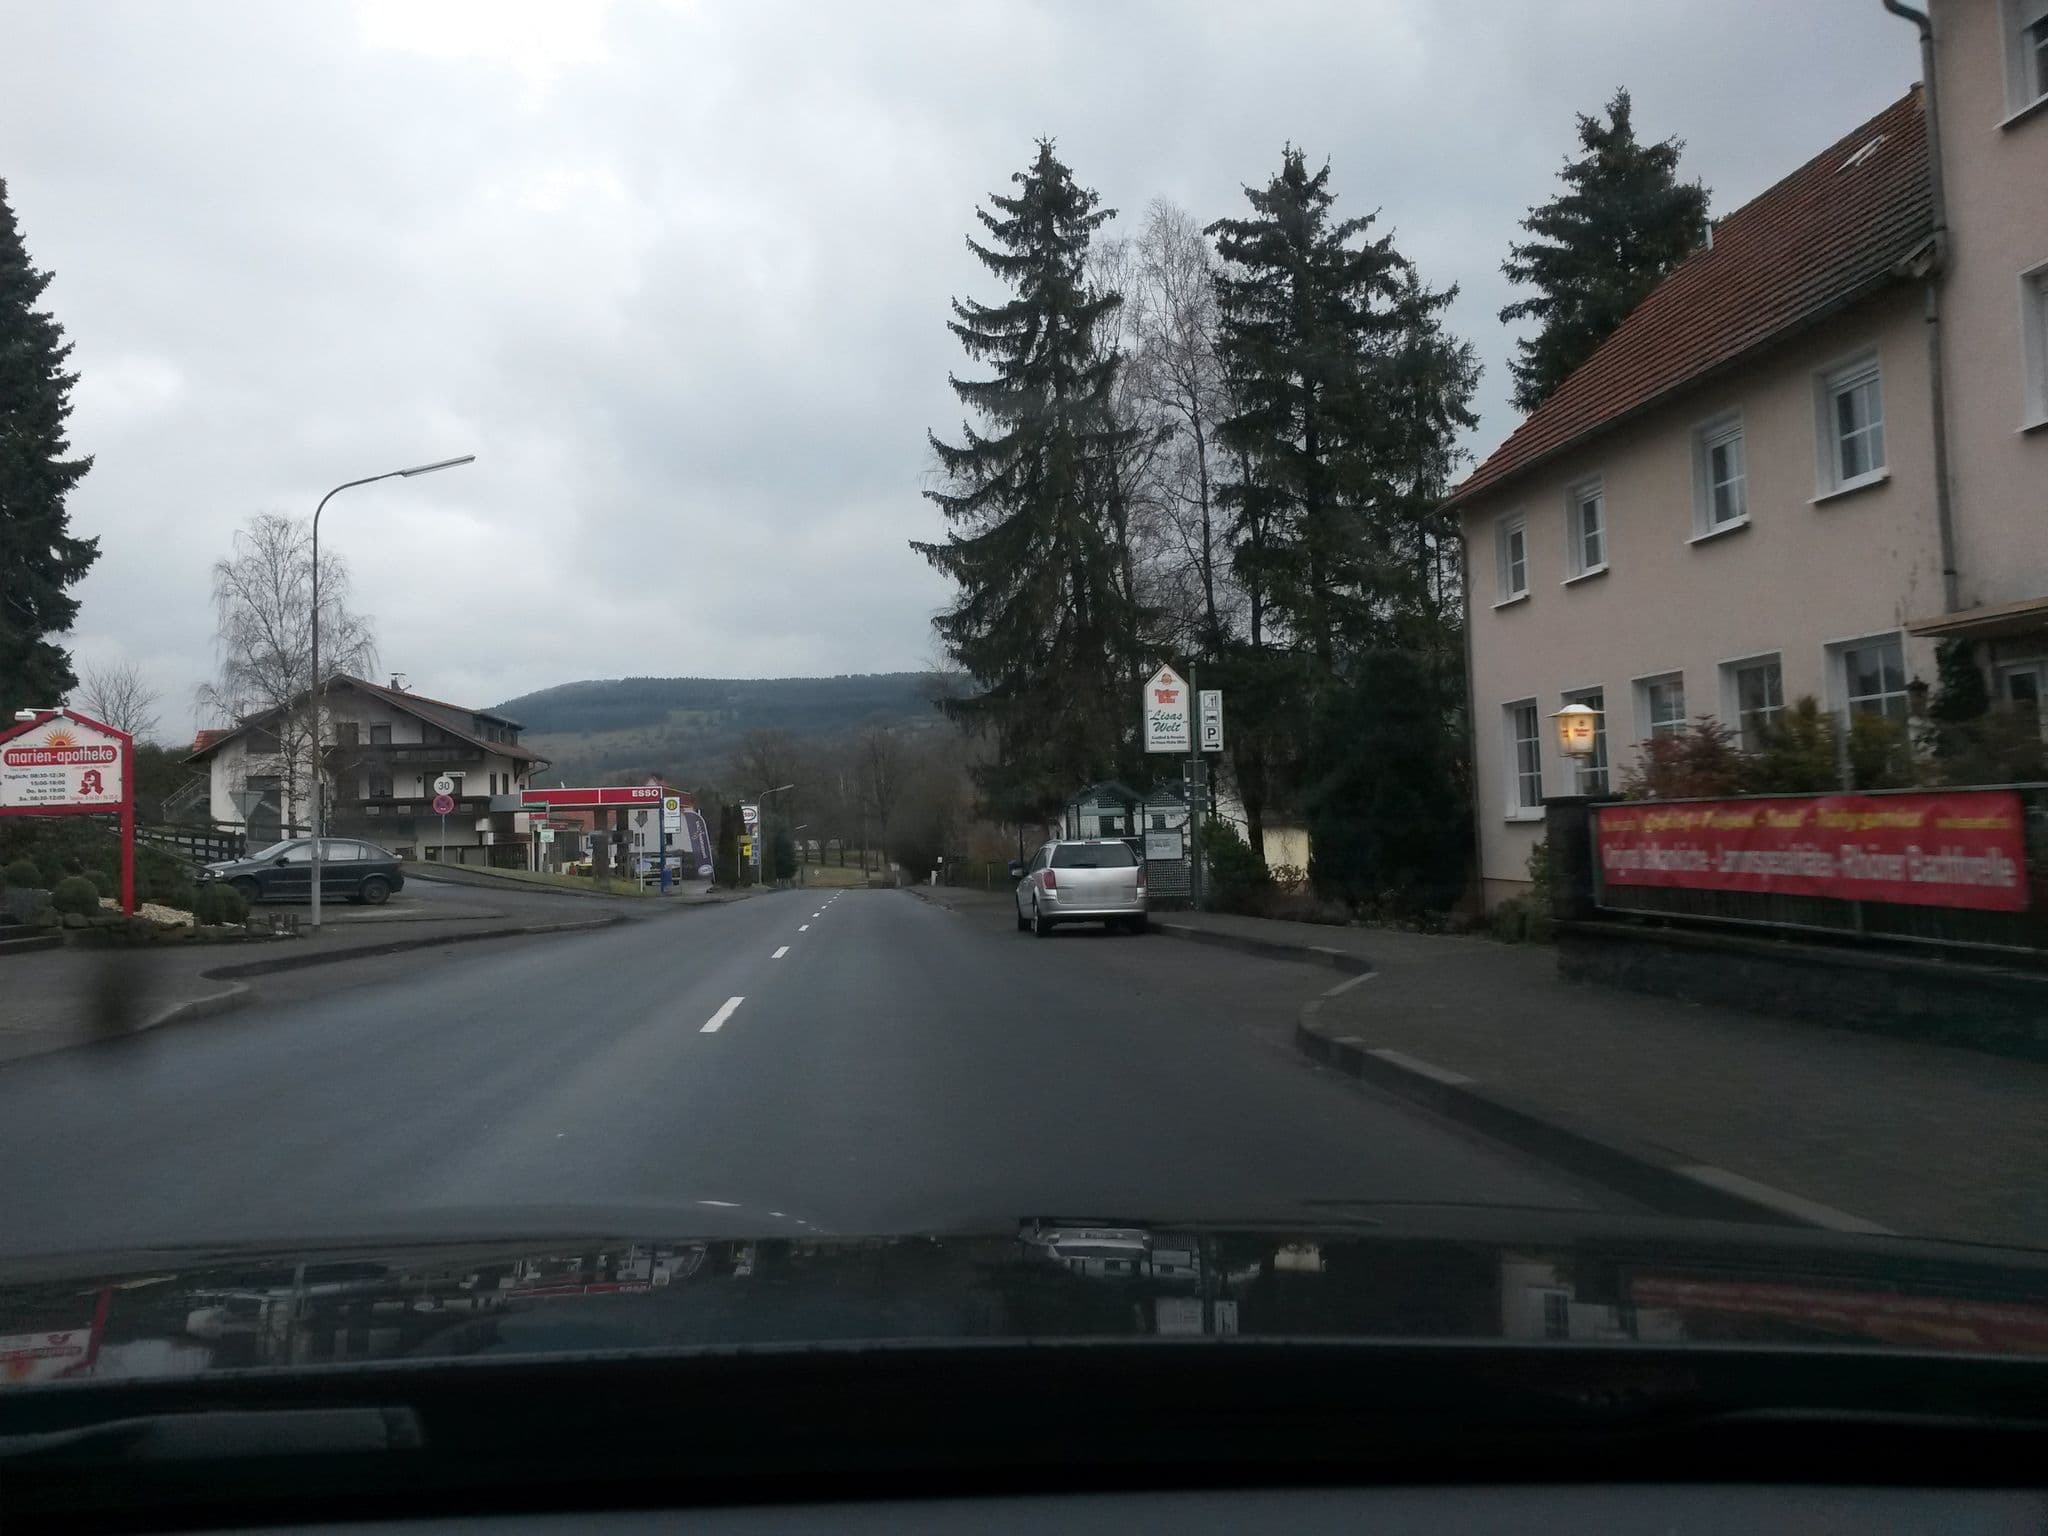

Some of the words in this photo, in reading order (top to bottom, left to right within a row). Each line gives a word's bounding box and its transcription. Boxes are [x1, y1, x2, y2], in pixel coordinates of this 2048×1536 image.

[1208, 727, 1216, 739] P
[8, 746, 113, 765] marien-apotheke
[438, 781, 450, 791] 30
[631, 789, 659, 798] ESSO
